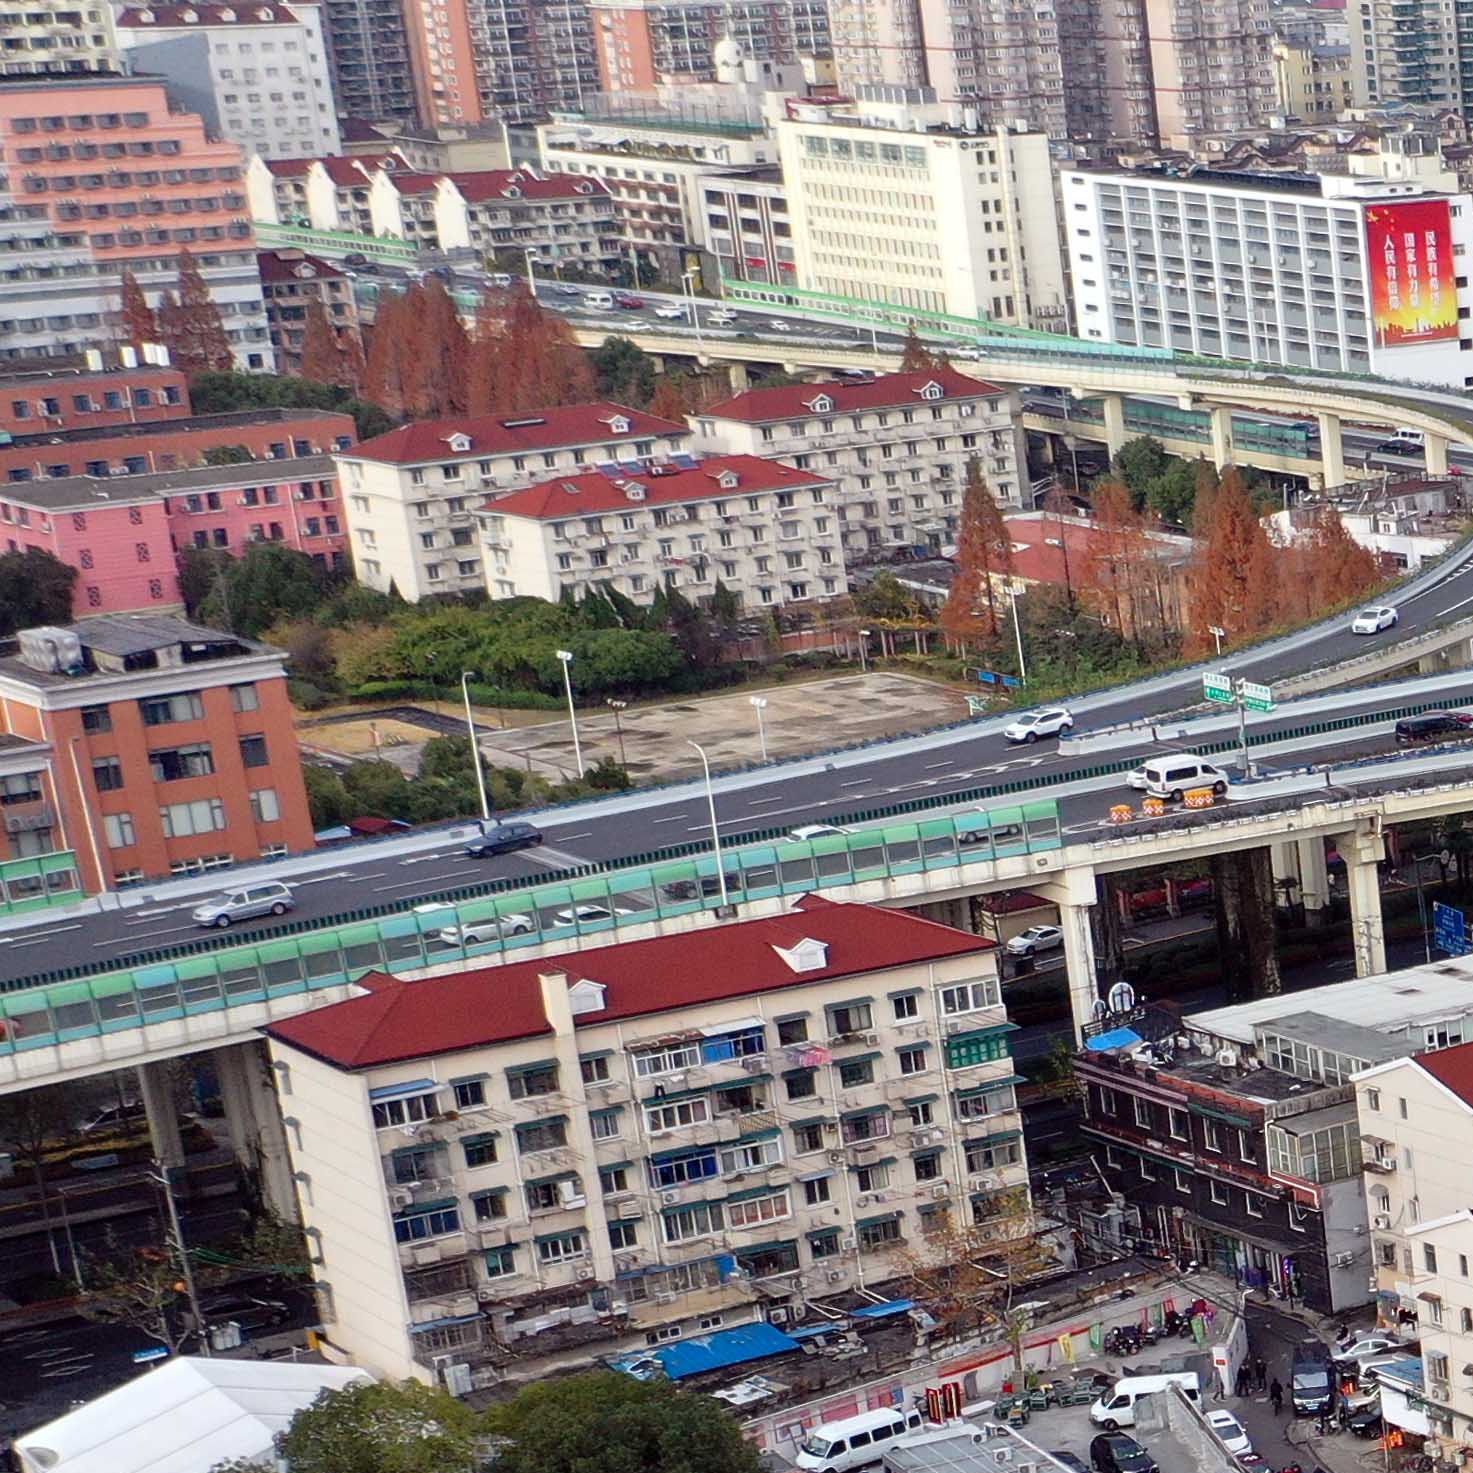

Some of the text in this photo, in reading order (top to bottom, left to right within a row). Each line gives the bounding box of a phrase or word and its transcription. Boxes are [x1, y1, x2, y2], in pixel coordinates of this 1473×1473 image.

[1384, 234, 1401, 311] 人民有信仰
[1403, 232, 1420, 309] 国家有力量
[1425, 231, 1441, 308] 民族有希望
